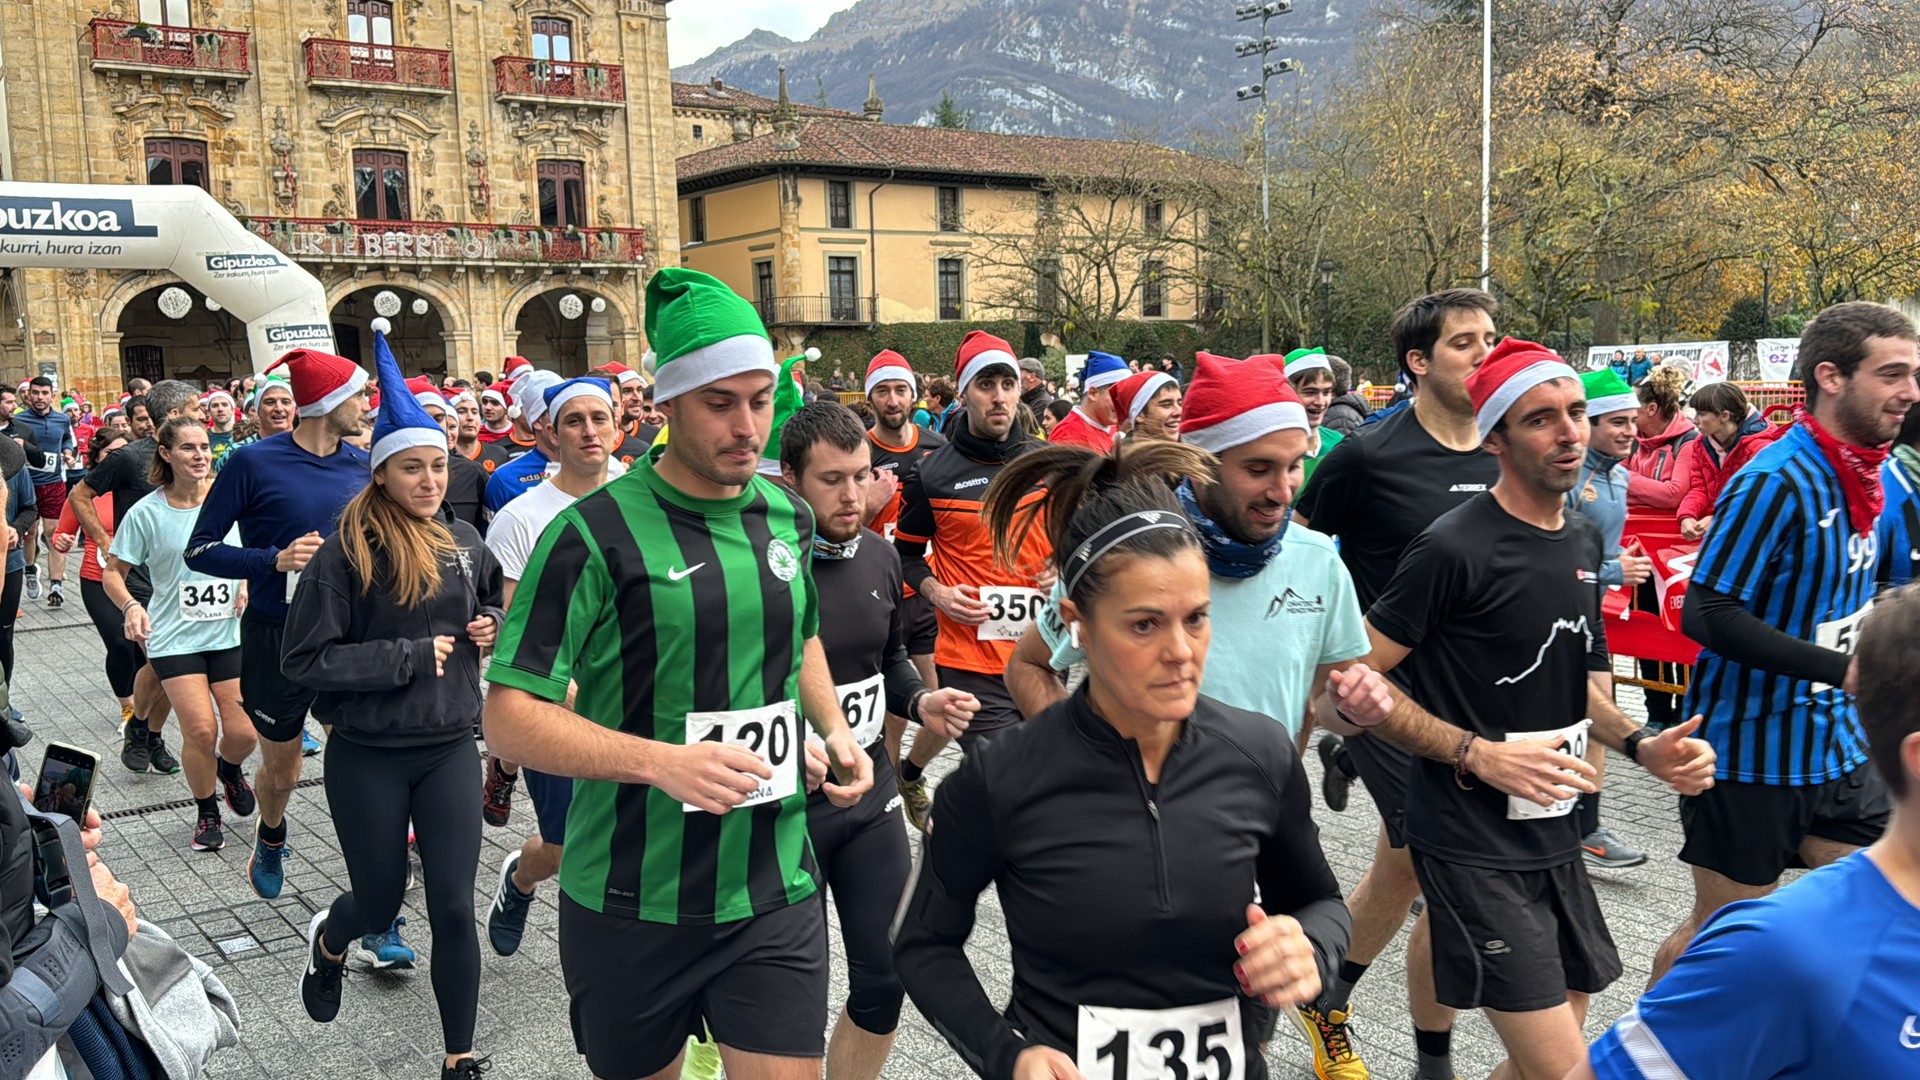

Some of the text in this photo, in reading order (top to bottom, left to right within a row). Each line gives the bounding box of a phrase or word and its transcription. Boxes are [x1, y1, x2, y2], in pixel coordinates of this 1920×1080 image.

[45, 240, 84, 255] hura
[88, 242, 122, 255] izan
[210, 256, 277, 270] Gipuzkoa
[213, 271, 225, 279] Zer
[269, 325, 328, 341] Gipuzkoa
[1769, 354, 1789, 363] ez
[1847, 530, 1877, 574] 99
[183, 583, 230, 607] 343
[987, 593, 1046, 622] 350
[1836, 616, 1862, 652] 5
[1096, 1017, 1232, 1080] 135
